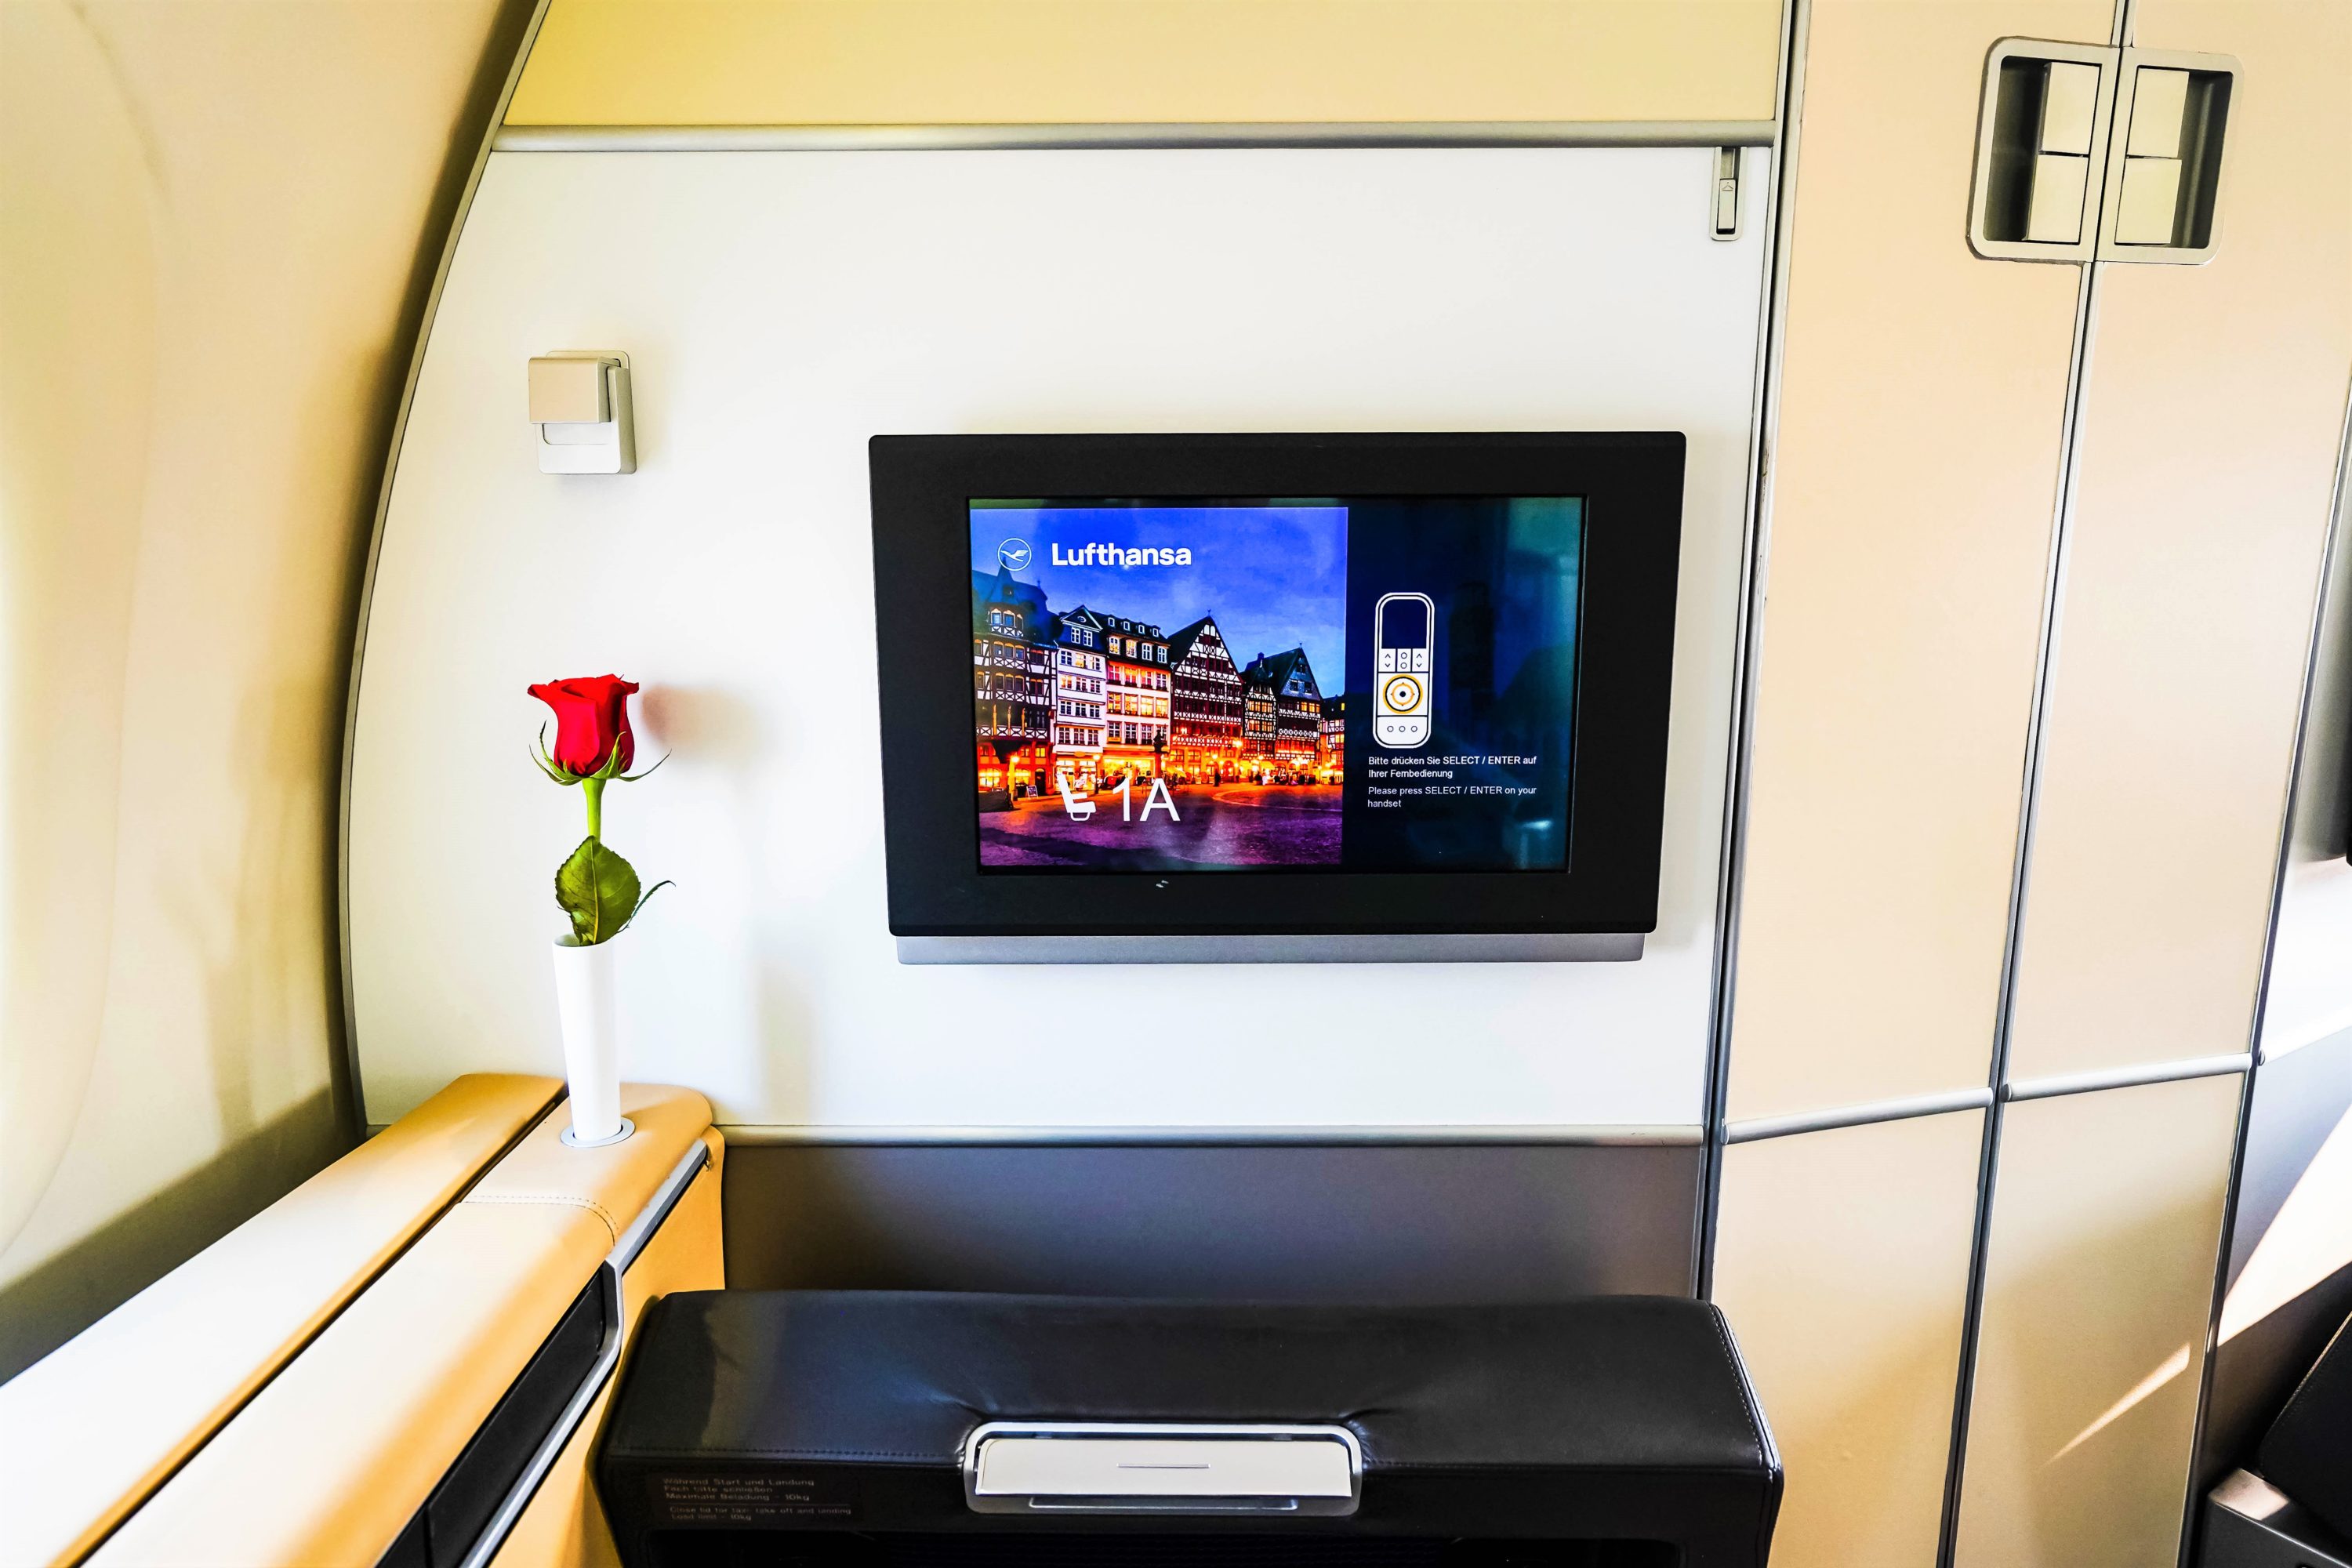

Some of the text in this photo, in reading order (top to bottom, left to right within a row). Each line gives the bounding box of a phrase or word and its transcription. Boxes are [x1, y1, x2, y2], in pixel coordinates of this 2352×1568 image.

[1051, 543, 1192, 566] Lufthansa
[1368, 757, 1389, 765] Bitte
[1391, 756, 1425, 765] drücken
[1426, 757, 1441, 765] Sie
[1443, 756, 1480, 764] SELECT
[1487, 756, 1521, 764] ENTER
[1523, 756, 1537, 764] auf
[1368, 769, 1388, 778] Ihrer
[1368, 786, 1397, 795] Please
[1399, 788, 1423, 797] press
[1112, 777, 1181, 822] 1A
